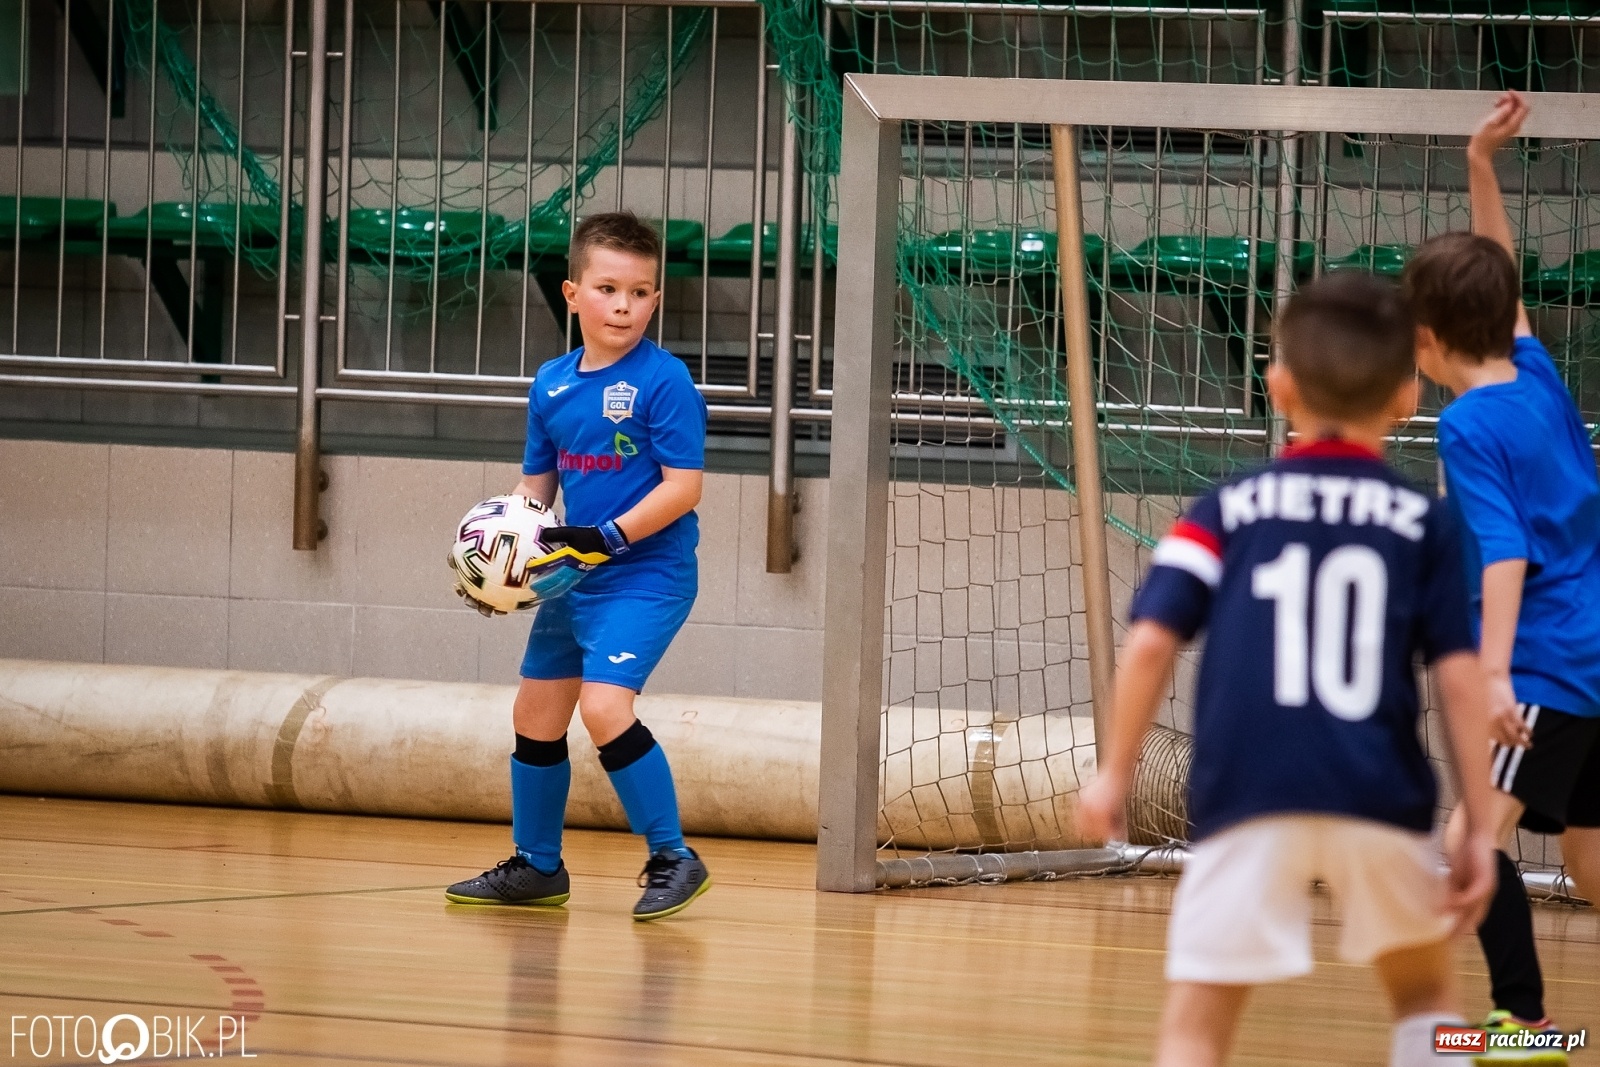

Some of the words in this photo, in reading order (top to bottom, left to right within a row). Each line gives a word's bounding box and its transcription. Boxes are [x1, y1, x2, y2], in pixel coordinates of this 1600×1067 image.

[610, 401, 627, 409] GOL
[1219, 473, 1429, 542] KIETRZ
[1252, 542, 1388, 722] 10
